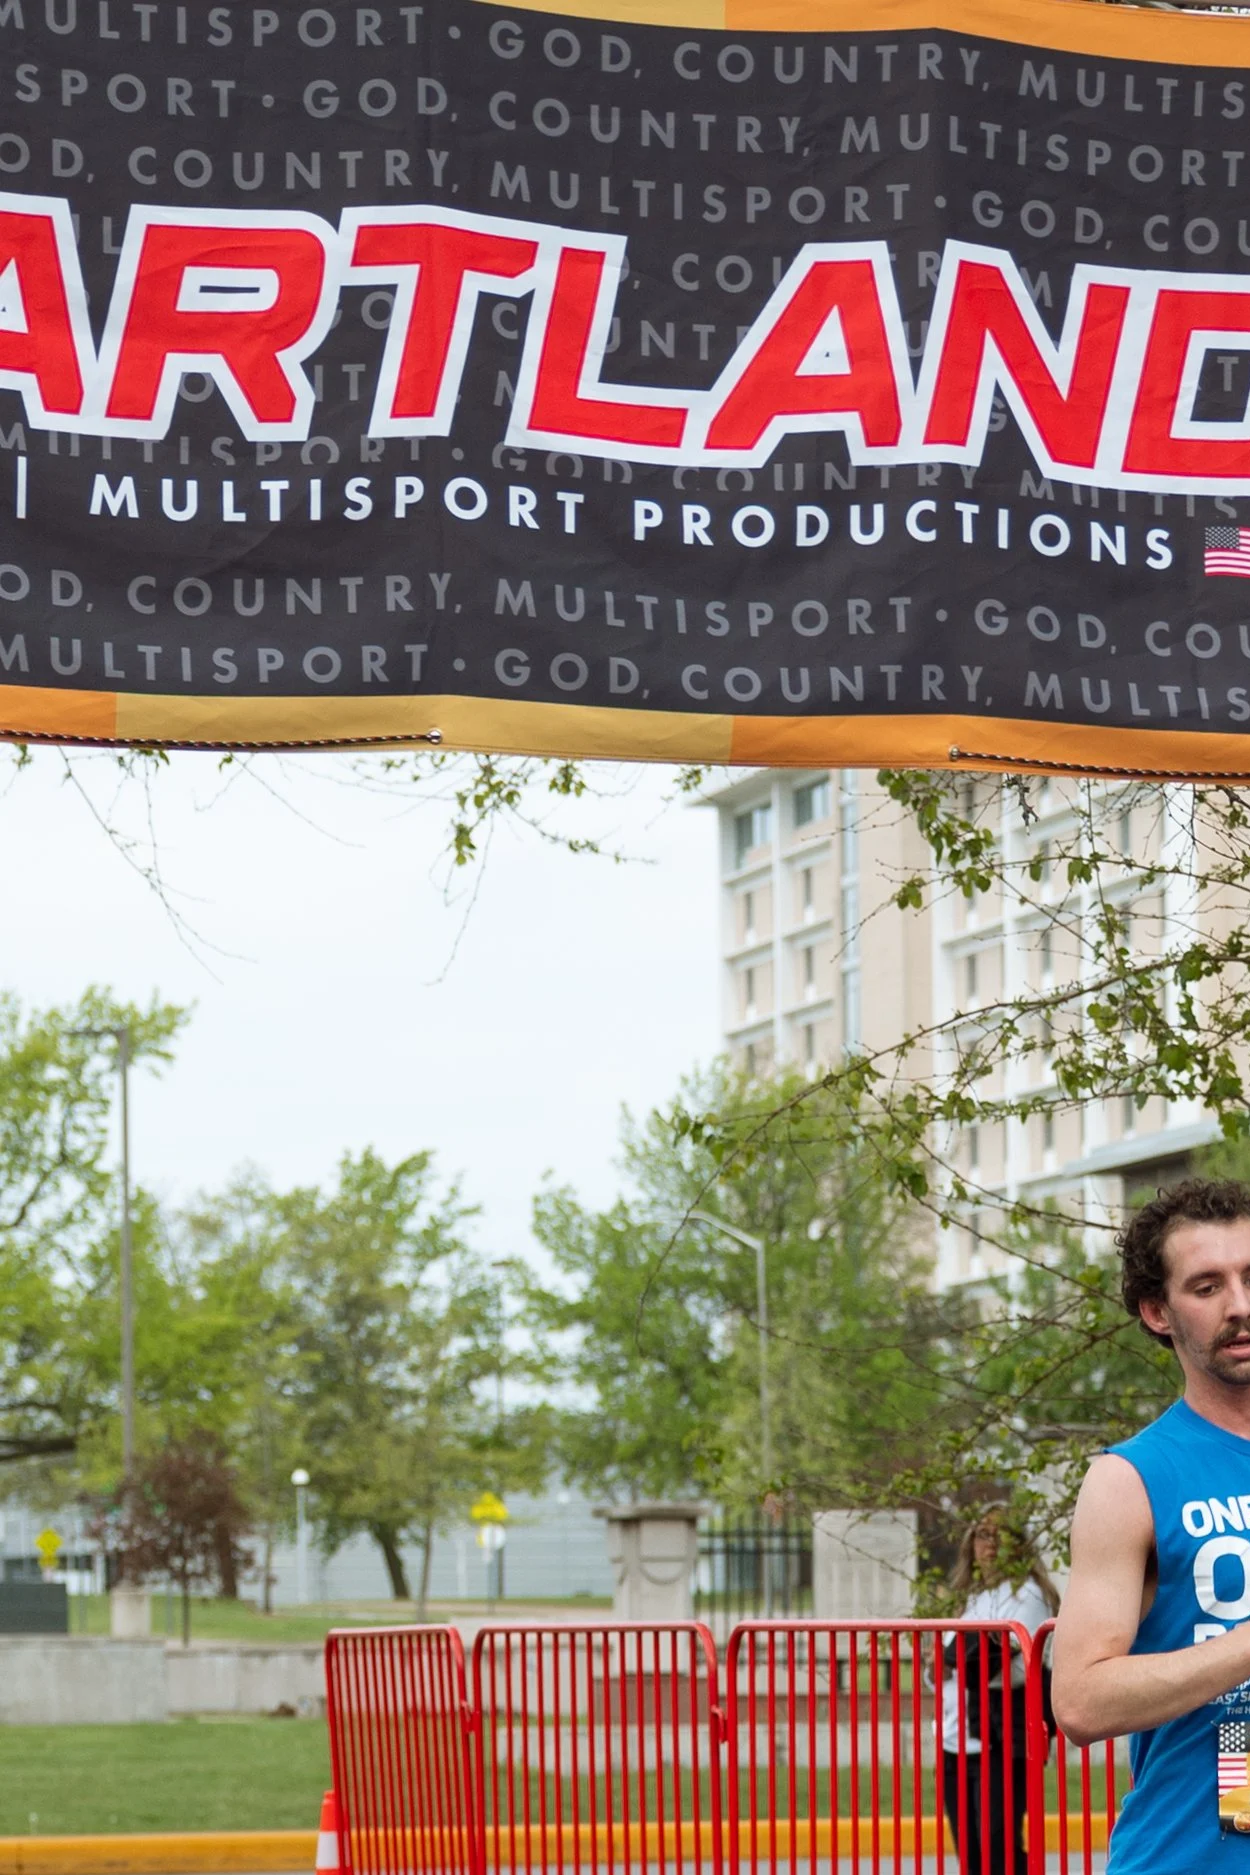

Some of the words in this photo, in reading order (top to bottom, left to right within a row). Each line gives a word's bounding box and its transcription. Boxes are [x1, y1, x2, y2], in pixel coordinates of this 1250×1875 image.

[489, 19, 641, 78] GOD,
[673, 42, 988, 91] COUNTRY,
[15, 63, 236, 117] SPORT
[303, 77, 457, 121] GOD,
[489, 90, 811, 158] COUNTRY,
[840, 113, 1245, 187] MULTISPORT
[128, 145, 459, 192] COUNTRY,
[490, 161, 909, 223] MULTISPORT
[972, 190, 1113, 251] GOD,
[89, 474, 585, 534] MULTISPORT
[634, 499, 1173, 571] PRODUCTIONS
[128, 572, 462, 616] COUNTRY,
[494, 578, 911, 637] MULTISPORT
[974, 598, 1117, 654] GOD,
[0, 634, 428, 684] MULTISPORT
[494, 648, 650, 699] GOD,
[681, 664, 992, 706] COUNTRY,
[1208, 1692, 1237, 1706] AST
